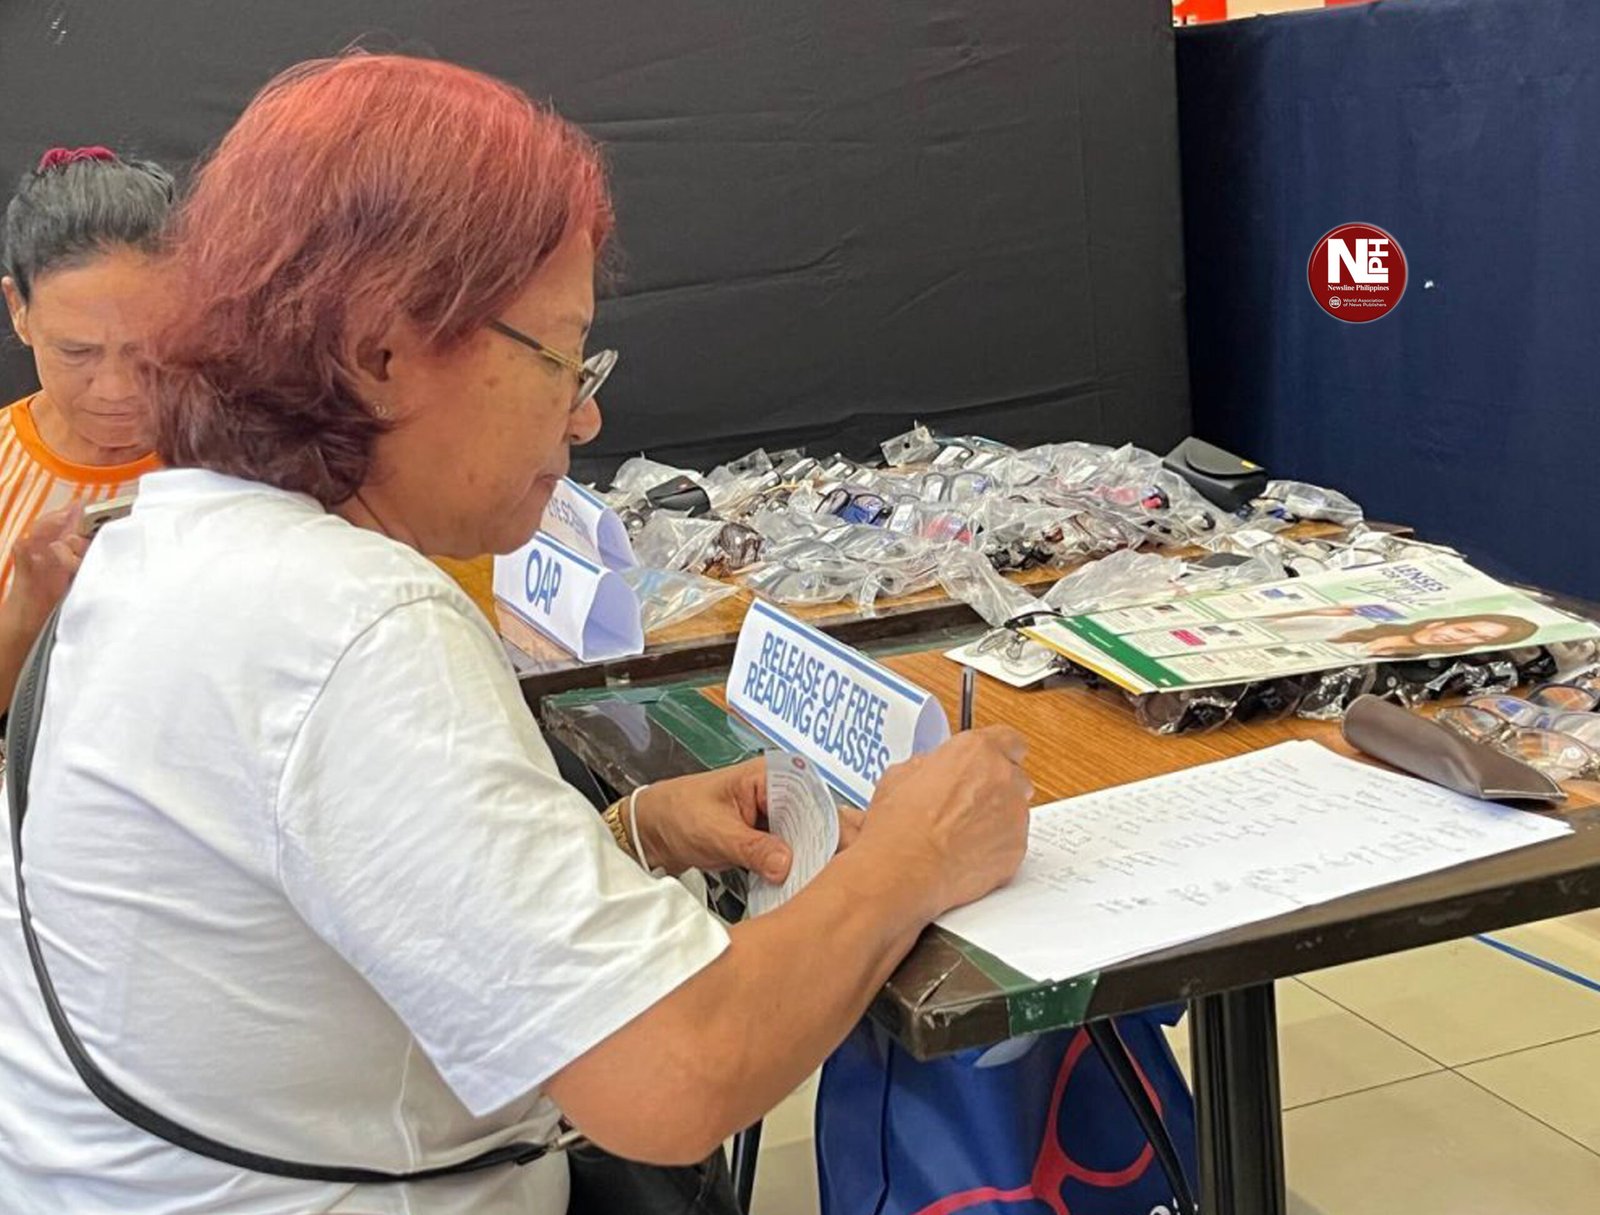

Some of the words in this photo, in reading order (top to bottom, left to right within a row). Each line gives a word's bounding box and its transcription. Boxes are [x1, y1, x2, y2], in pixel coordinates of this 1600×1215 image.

[525, 548, 562, 616] OAP
[1393, 563, 1451, 592] LENSES
[743, 661, 815, 737] READING
[813, 706, 890, 785] GLASSES
[759, 631, 825, 700] RELEASE
[822, 669, 850, 714] OF
[844, 683, 889, 742] FREE
